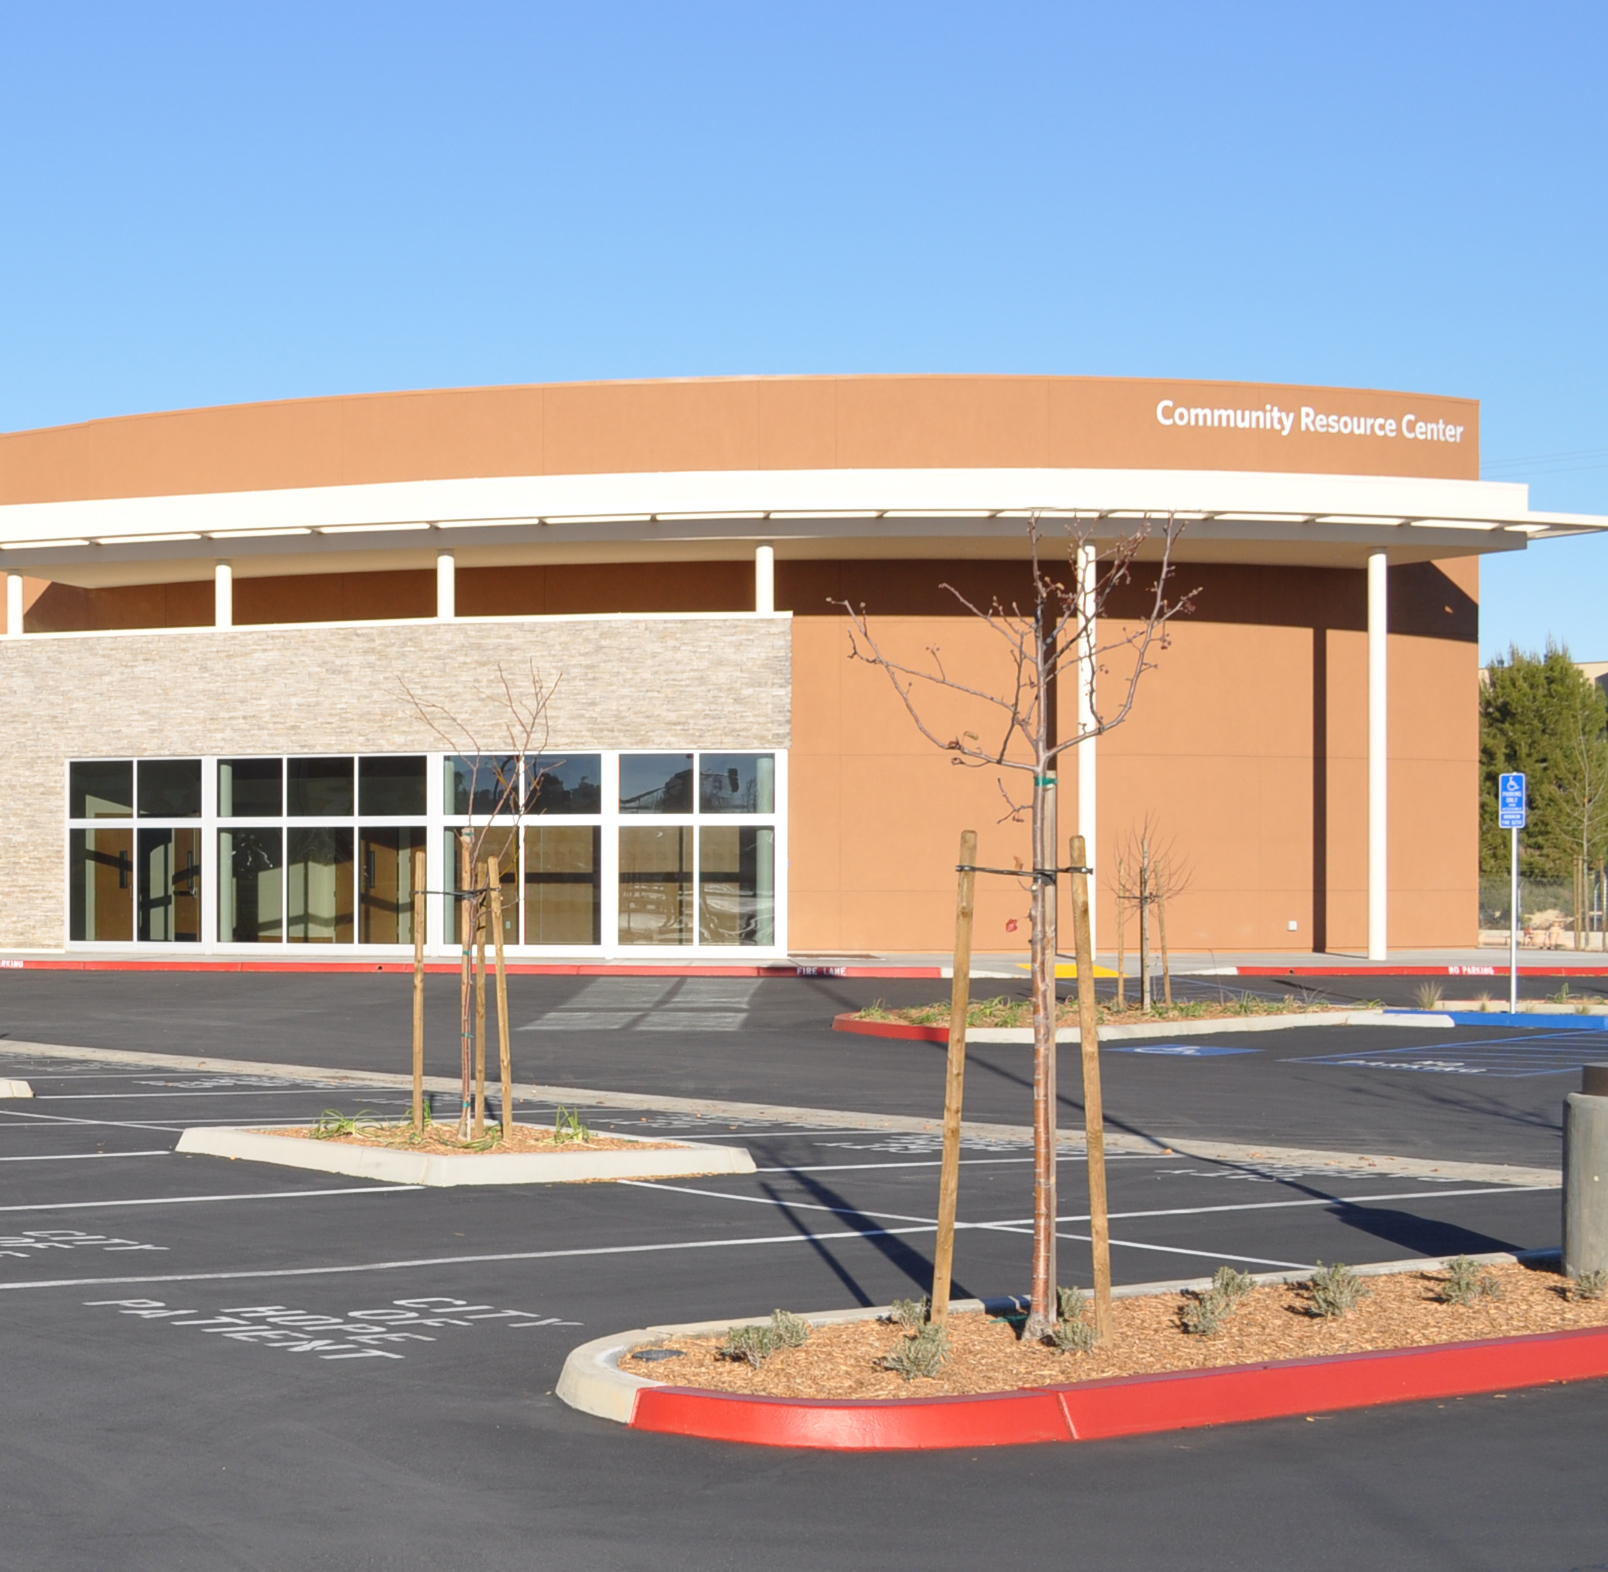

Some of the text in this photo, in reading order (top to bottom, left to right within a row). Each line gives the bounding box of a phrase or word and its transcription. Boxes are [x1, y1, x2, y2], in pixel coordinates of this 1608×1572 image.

[1155, 399, 1465, 443] Community Resource Center
[796, 966, 847, 976] FIRE LANE
[1448, 966, 1495, 975] NO PARKING
[21, 1230, 171, 1251] CITY
[220, 1305, 438, 1345] HOPE
[346, 1309, 474, 1327] OF
[392, 1296, 586, 1328] CITY
[82, 1298, 406, 1360] PATIENT
